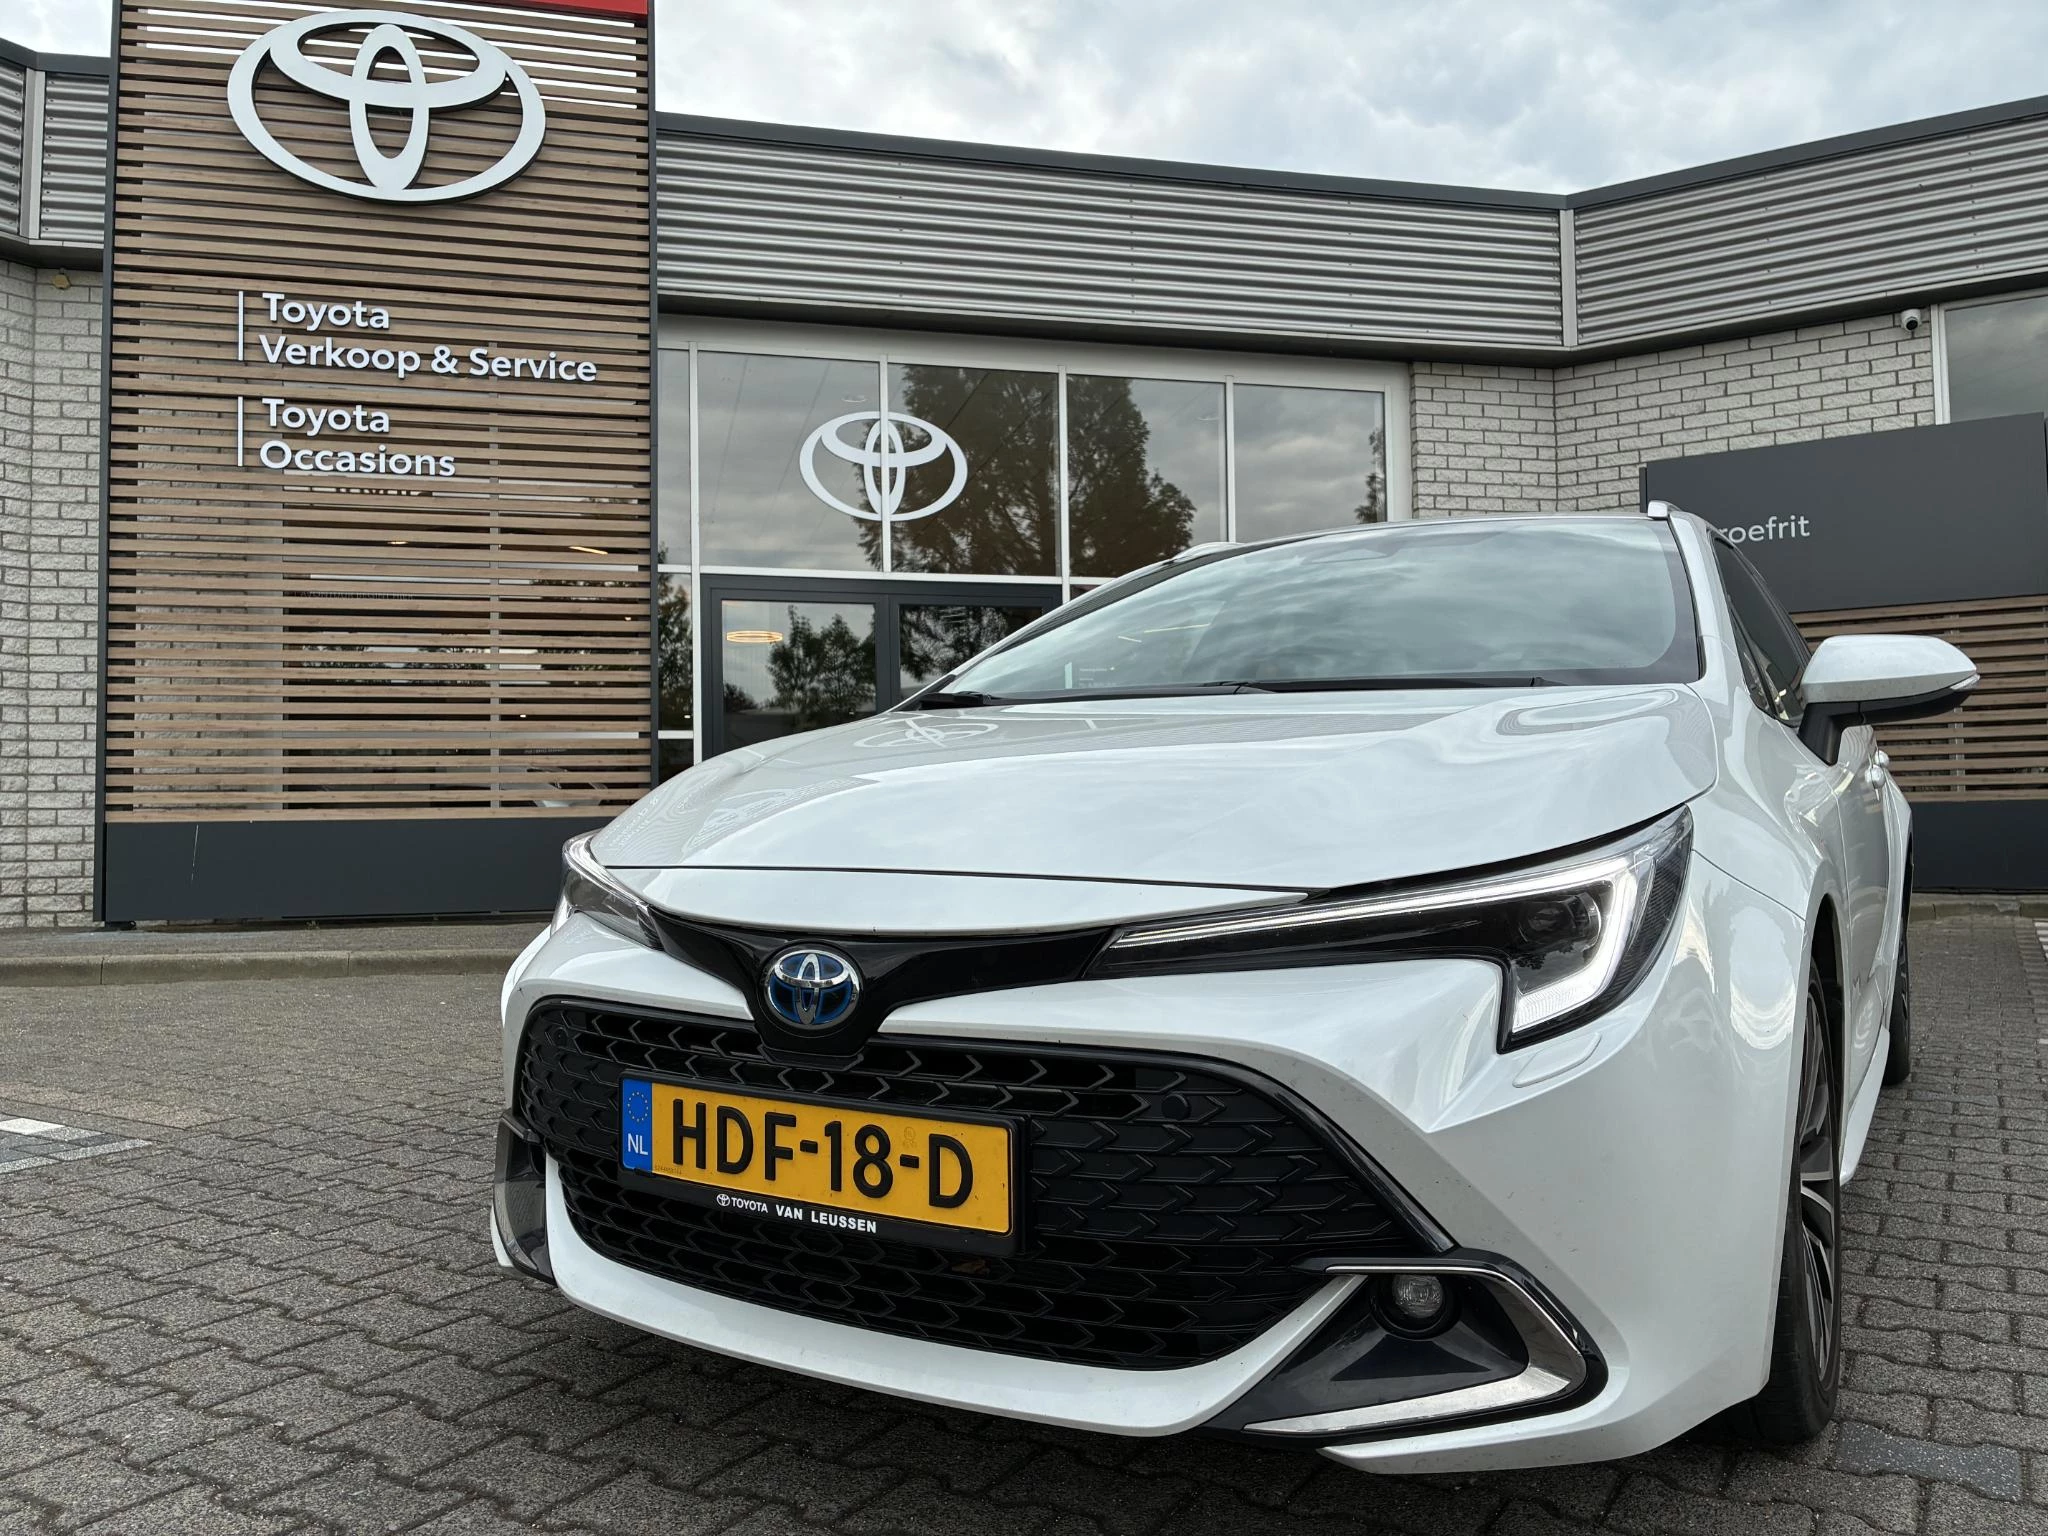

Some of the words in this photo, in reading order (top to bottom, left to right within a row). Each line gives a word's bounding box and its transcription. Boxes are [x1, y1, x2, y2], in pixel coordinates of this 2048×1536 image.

[262, 292, 390, 331] Toyota
[259, 334, 421, 378] Verkoop
[431, 345, 459, 374] &
[469, 348, 598, 382] Service
[262, 398, 390, 436] Toyota
[260, 440, 456, 476] Occasions
[1719, 514, 1811, 544] roefrit
[627, 1133, 649, 1156] NL
[672, 1098, 974, 1209] HDF-18-D
[731, 1197, 769, 1213] TOYOTA
[775, 1204, 803, 1221] VAN
[811, 1210, 877, 1234] LEUSSEN
